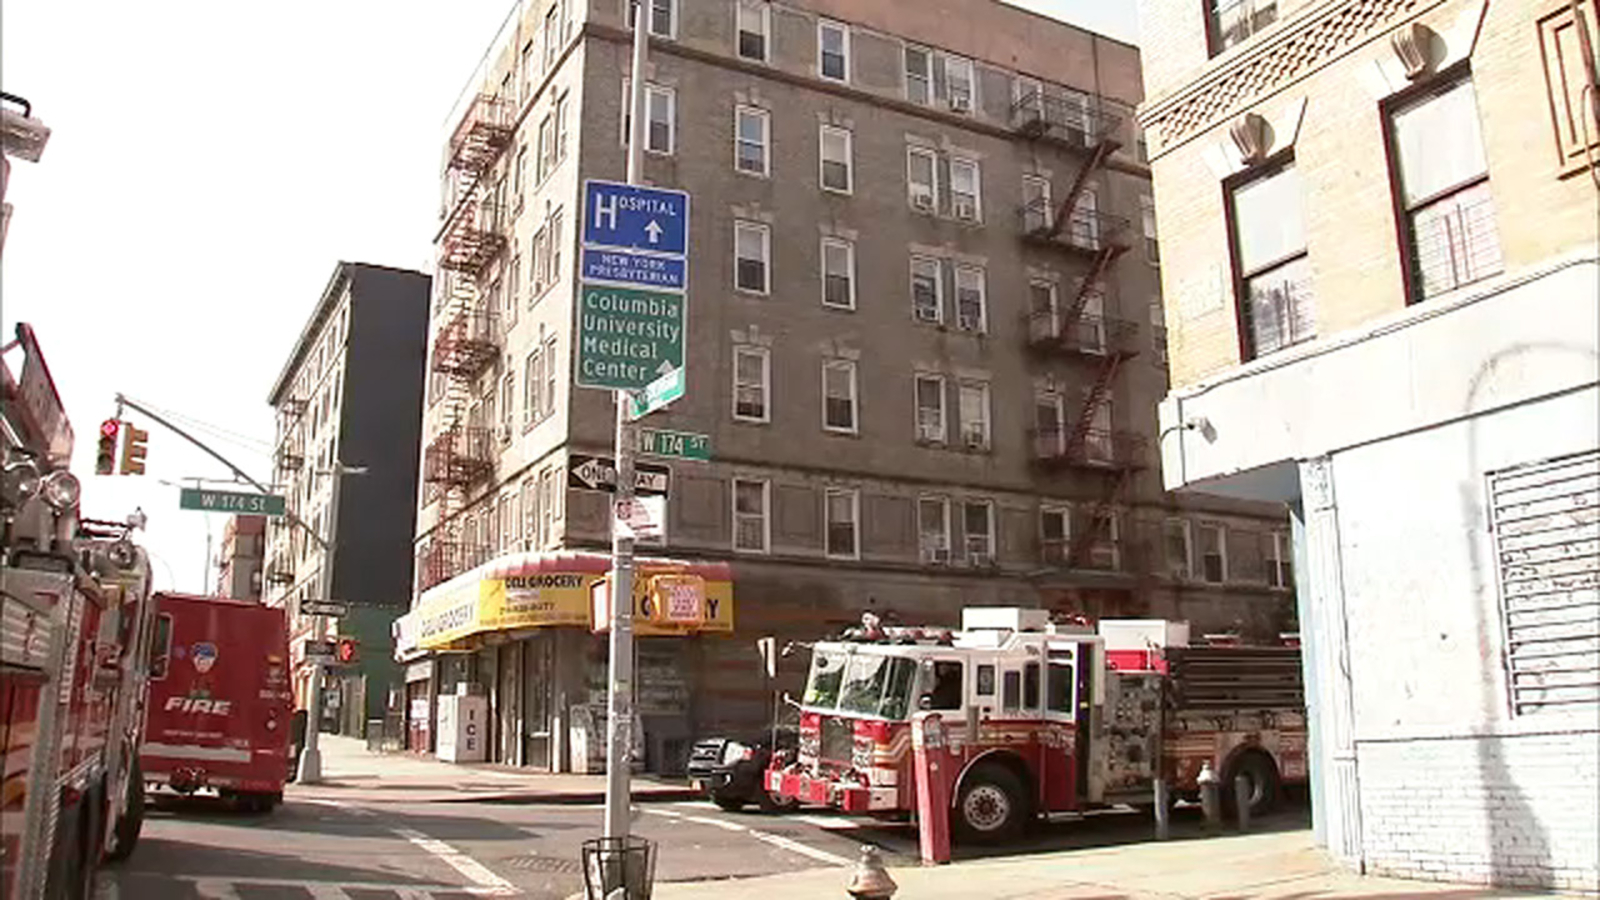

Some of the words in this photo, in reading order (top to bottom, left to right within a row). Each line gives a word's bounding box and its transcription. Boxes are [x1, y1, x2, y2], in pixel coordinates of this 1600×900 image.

[589, 264, 679, 284] PRESBYTERIAN
[601, 254, 628, 267] NEW
[633, 258, 666, 271] YORK
[587, 291, 679, 318] Columbia
[584, 314, 681, 344] University
[584, 336, 658, 359] Medical
[583, 358, 648, 381] Center
[641, 431, 656, 452] W
[662, 434, 685, 456] 174
[202, 494, 216, 507] W
[222, 495, 245, 510] 174
[505, 577, 526, 589] DELI
[528, 575, 584, 589] GROCERY
[164, 696, 231, 716] FIRE
[466, 709, 476, 751] ICE
